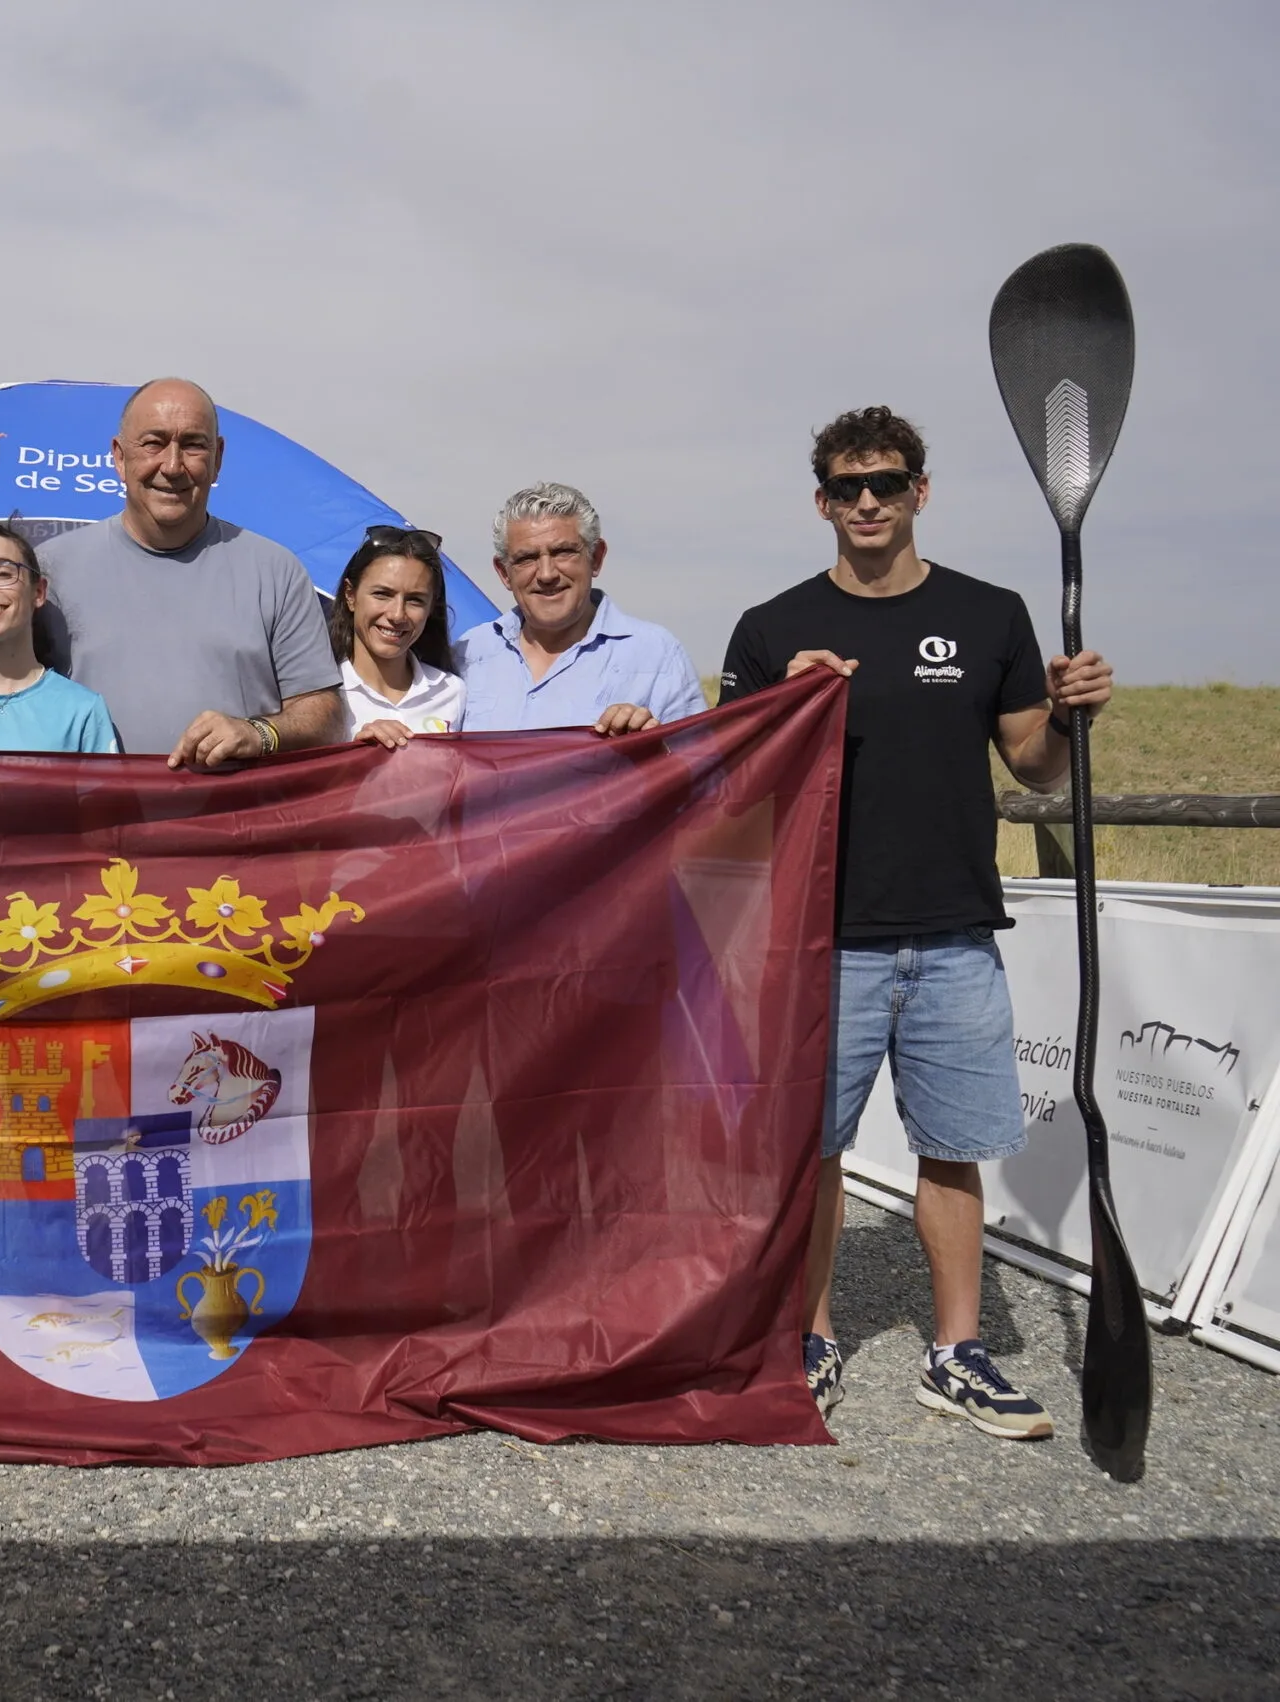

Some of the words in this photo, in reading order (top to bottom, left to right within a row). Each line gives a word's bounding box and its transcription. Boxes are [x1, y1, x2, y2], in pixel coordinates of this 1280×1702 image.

[15, 471, 61, 491] de
[914, 665, 965, 678] Alimentos
[1012, 1033, 1072, 1070] tación
[1116, 1069, 1163, 1089] NUESTROS
[1166, 1079, 1215, 1100] PUEBLOS.
[1117, 1090, 1153, 1106] NUESTRA
[1156, 1097, 1201, 1116] FORTALEZA
